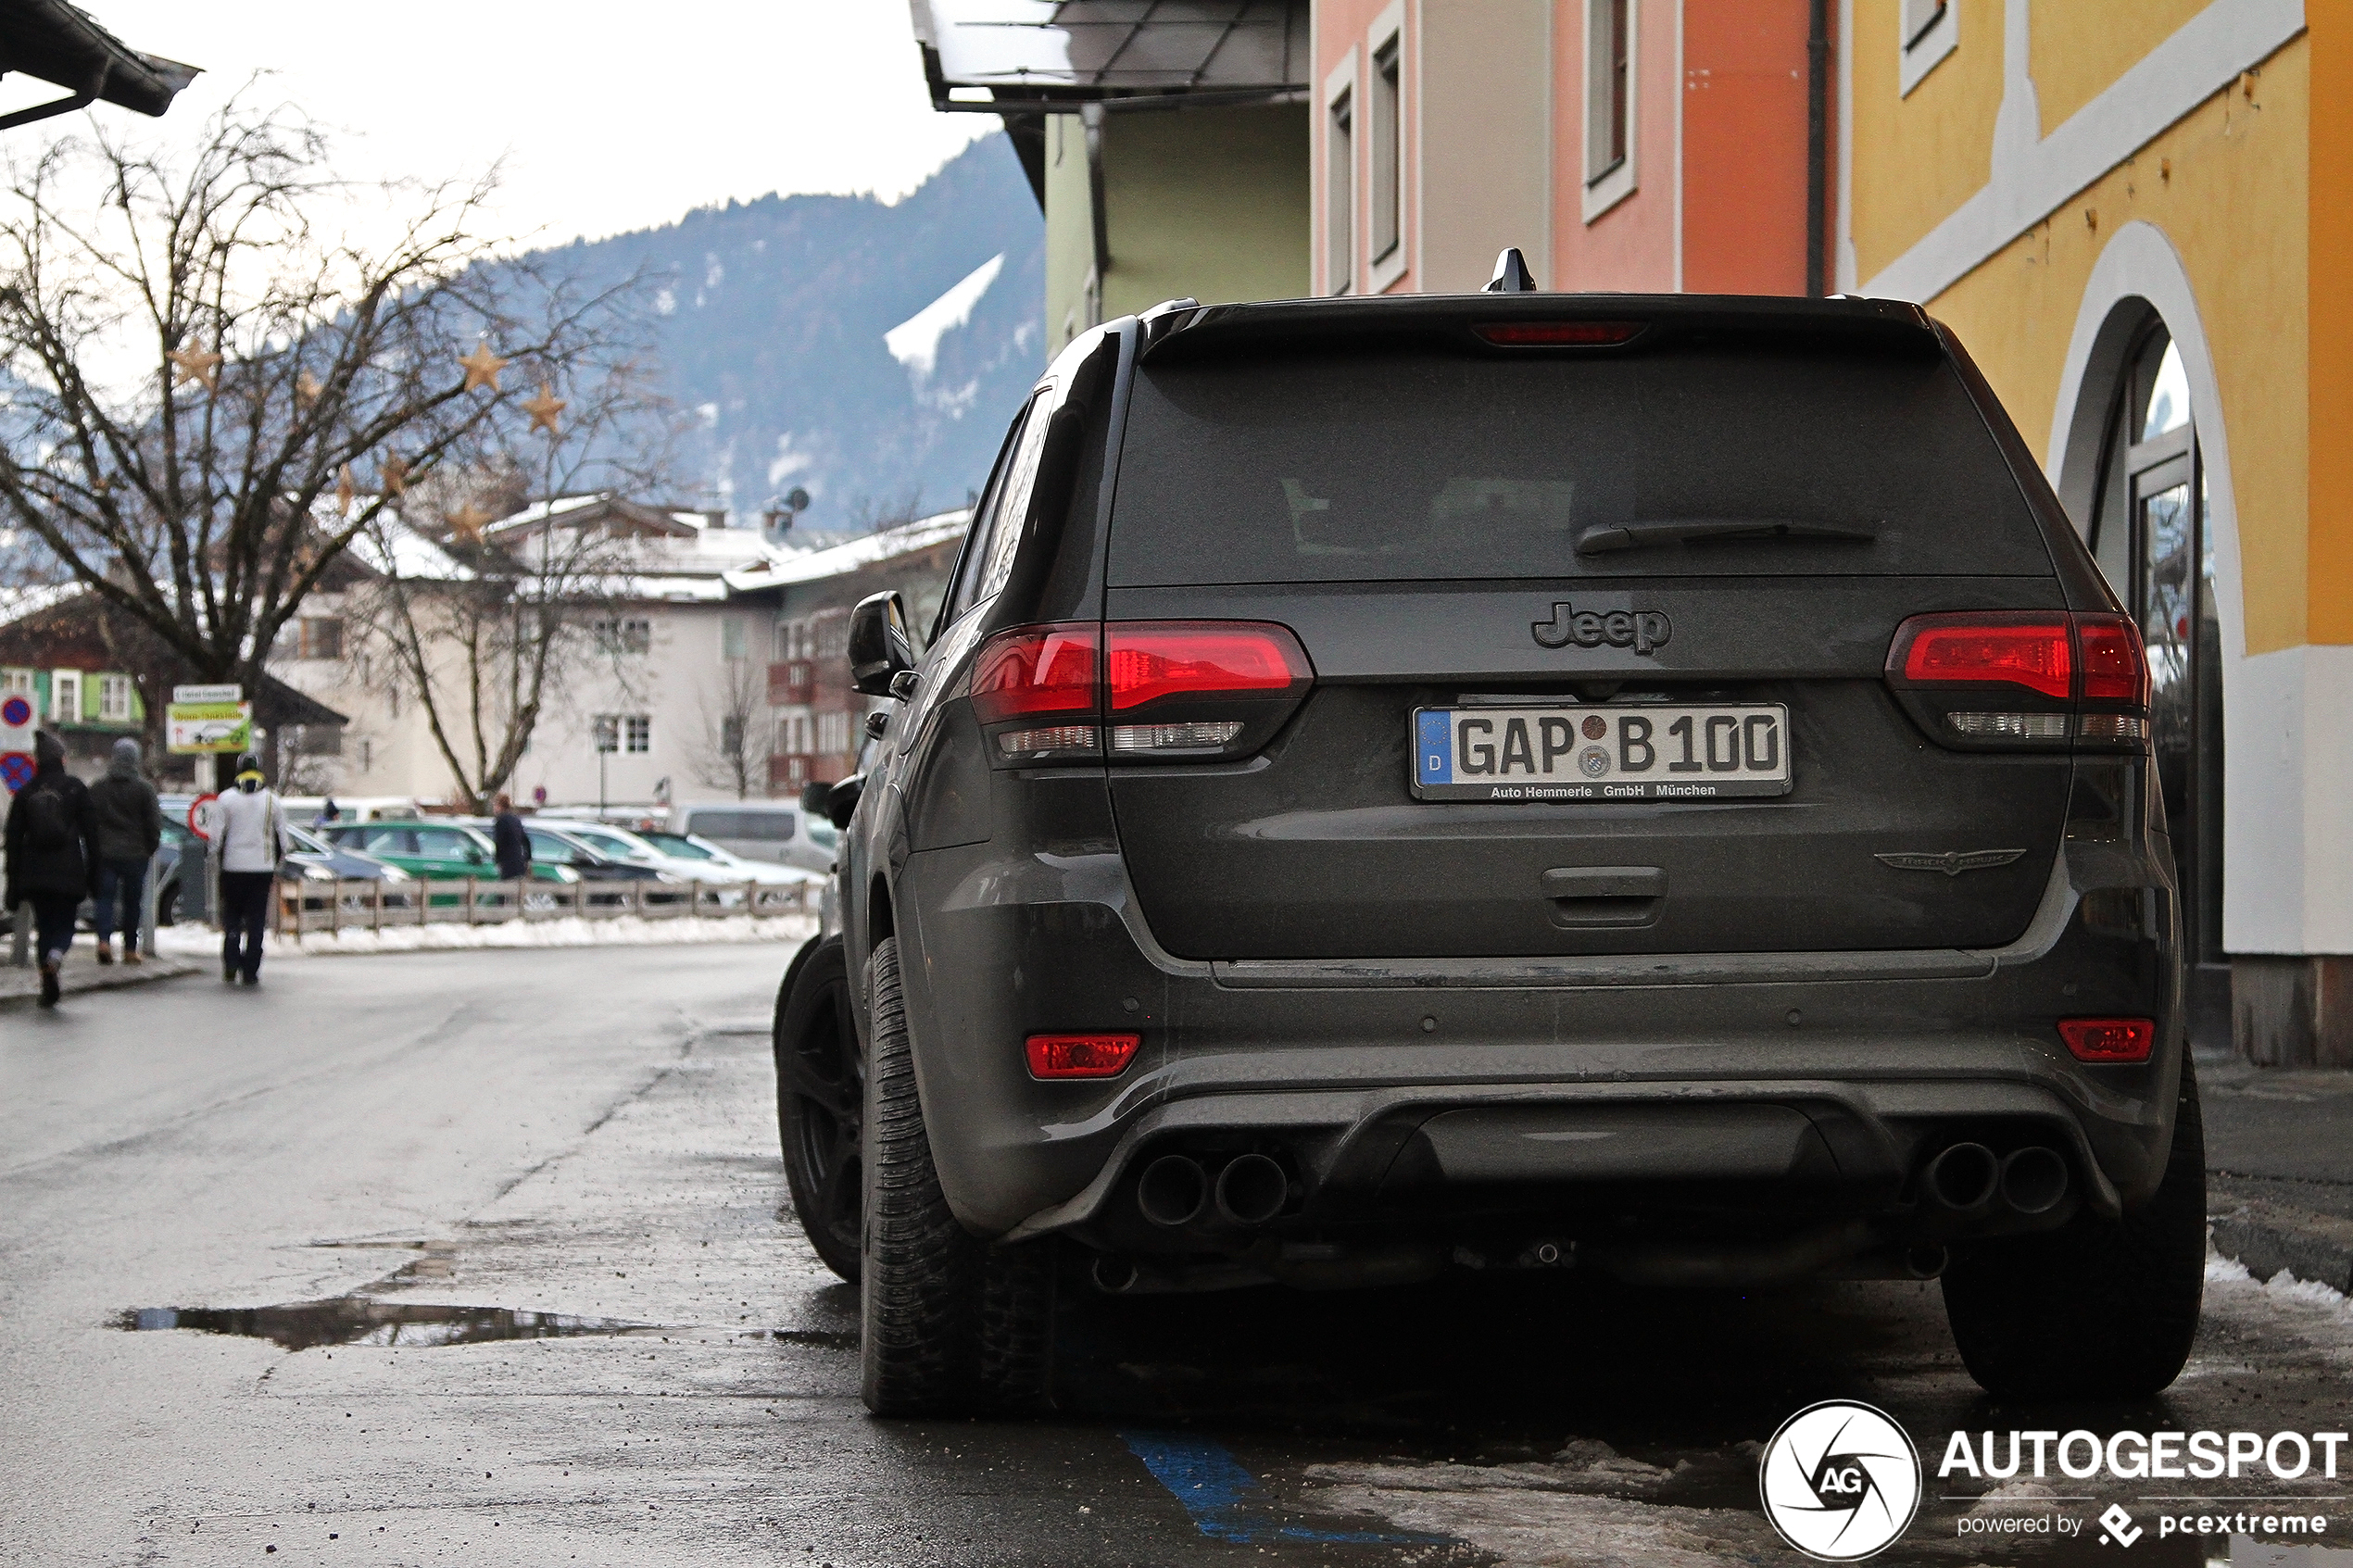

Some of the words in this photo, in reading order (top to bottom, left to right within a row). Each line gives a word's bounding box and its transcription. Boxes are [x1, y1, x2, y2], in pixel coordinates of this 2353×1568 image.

[1532, 602, 1674, 655] Jeep
[1428, 754, 1441, 771] D
[1457, 717, 1575, 774] GAP
[1491, 786, 1522, 798] Auto
[1525, 785, 1592, 798] Hemmerle
[1604, 784, 1644, 797] GmbH
[1655, 784, 1716, 797] München
